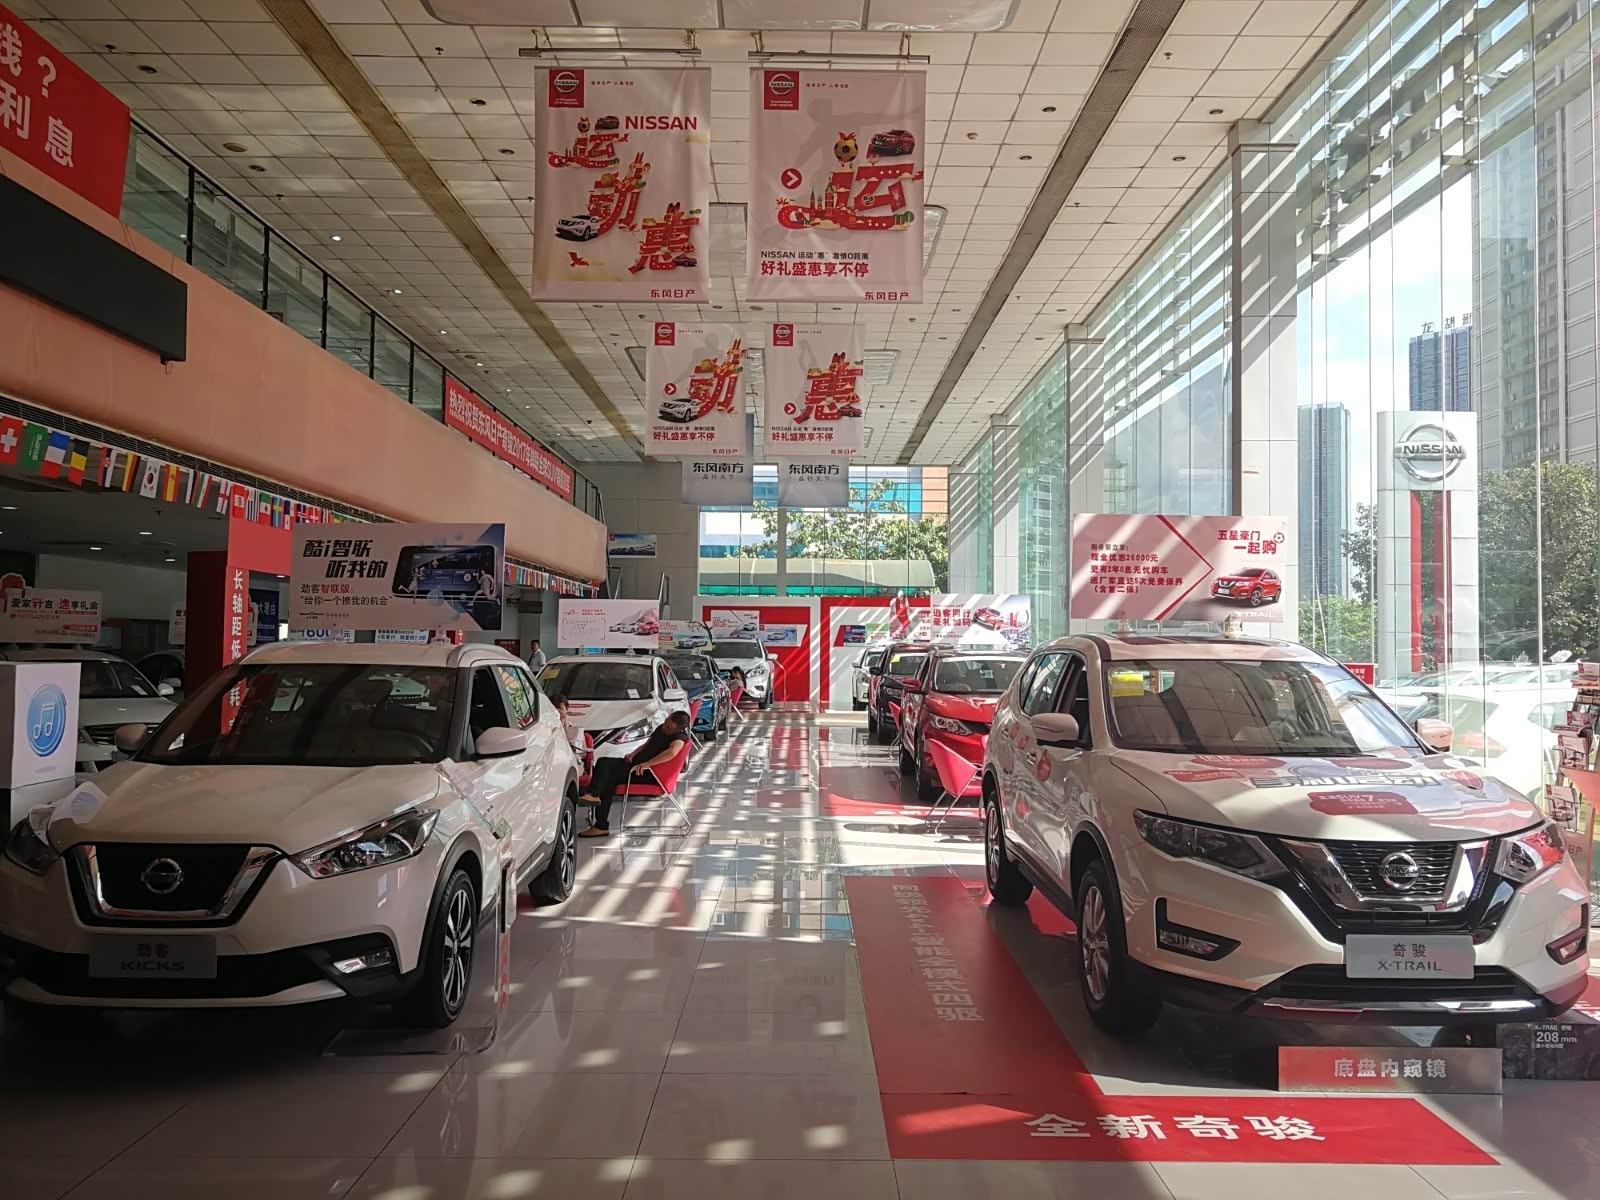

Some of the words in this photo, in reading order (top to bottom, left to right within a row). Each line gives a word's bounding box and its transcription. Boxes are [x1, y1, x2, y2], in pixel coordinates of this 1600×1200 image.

[625, 115, 697, 130] NISSAN
[760, 251, 796, 259] NISSAN
[760, 260, 869, 277] 好礼盛惠享不停
[650, 289, 695, 298] 东风日产
[864, 291, 909, 300] 东风日产
[653, 432, 715, 441] 好礼盛惠享不停
[771, 432, 834, 442] 好礼盛惠享不停
[1403, 444, 1462, 455] NISSAN
[692, 462, 744, 474] 东风南方
[788, 463, 840, 475] 东风南方
[1217, 529, 1261, 541] 五星豪门
[303, 539, 374, 558] 酷i智联
[1234, 540, 1278, 555] 一起购
[1090, 553, 1159, 562] 现金优惠26000元
[325, 560, 388, 578] 听我的
[1090, 565, 1169, 574] 更有2年0息无忧购车
[1089, 576, 1184, 587] 送厂家直达5次免费保养
[136, 942, 169, 958] 劲客
[1392, 943, 1427, 958] 奇骏
[120, 959, 185, 971] KICKS
[1377, 960, 1443, 971] X-TRAIL
[1536, 1031, 1559, 1043] 208
[1334, 1058, 1447, 1079] 底盘内窥镜
[1023, 1113, 1326, 1141] 全新奇骏
